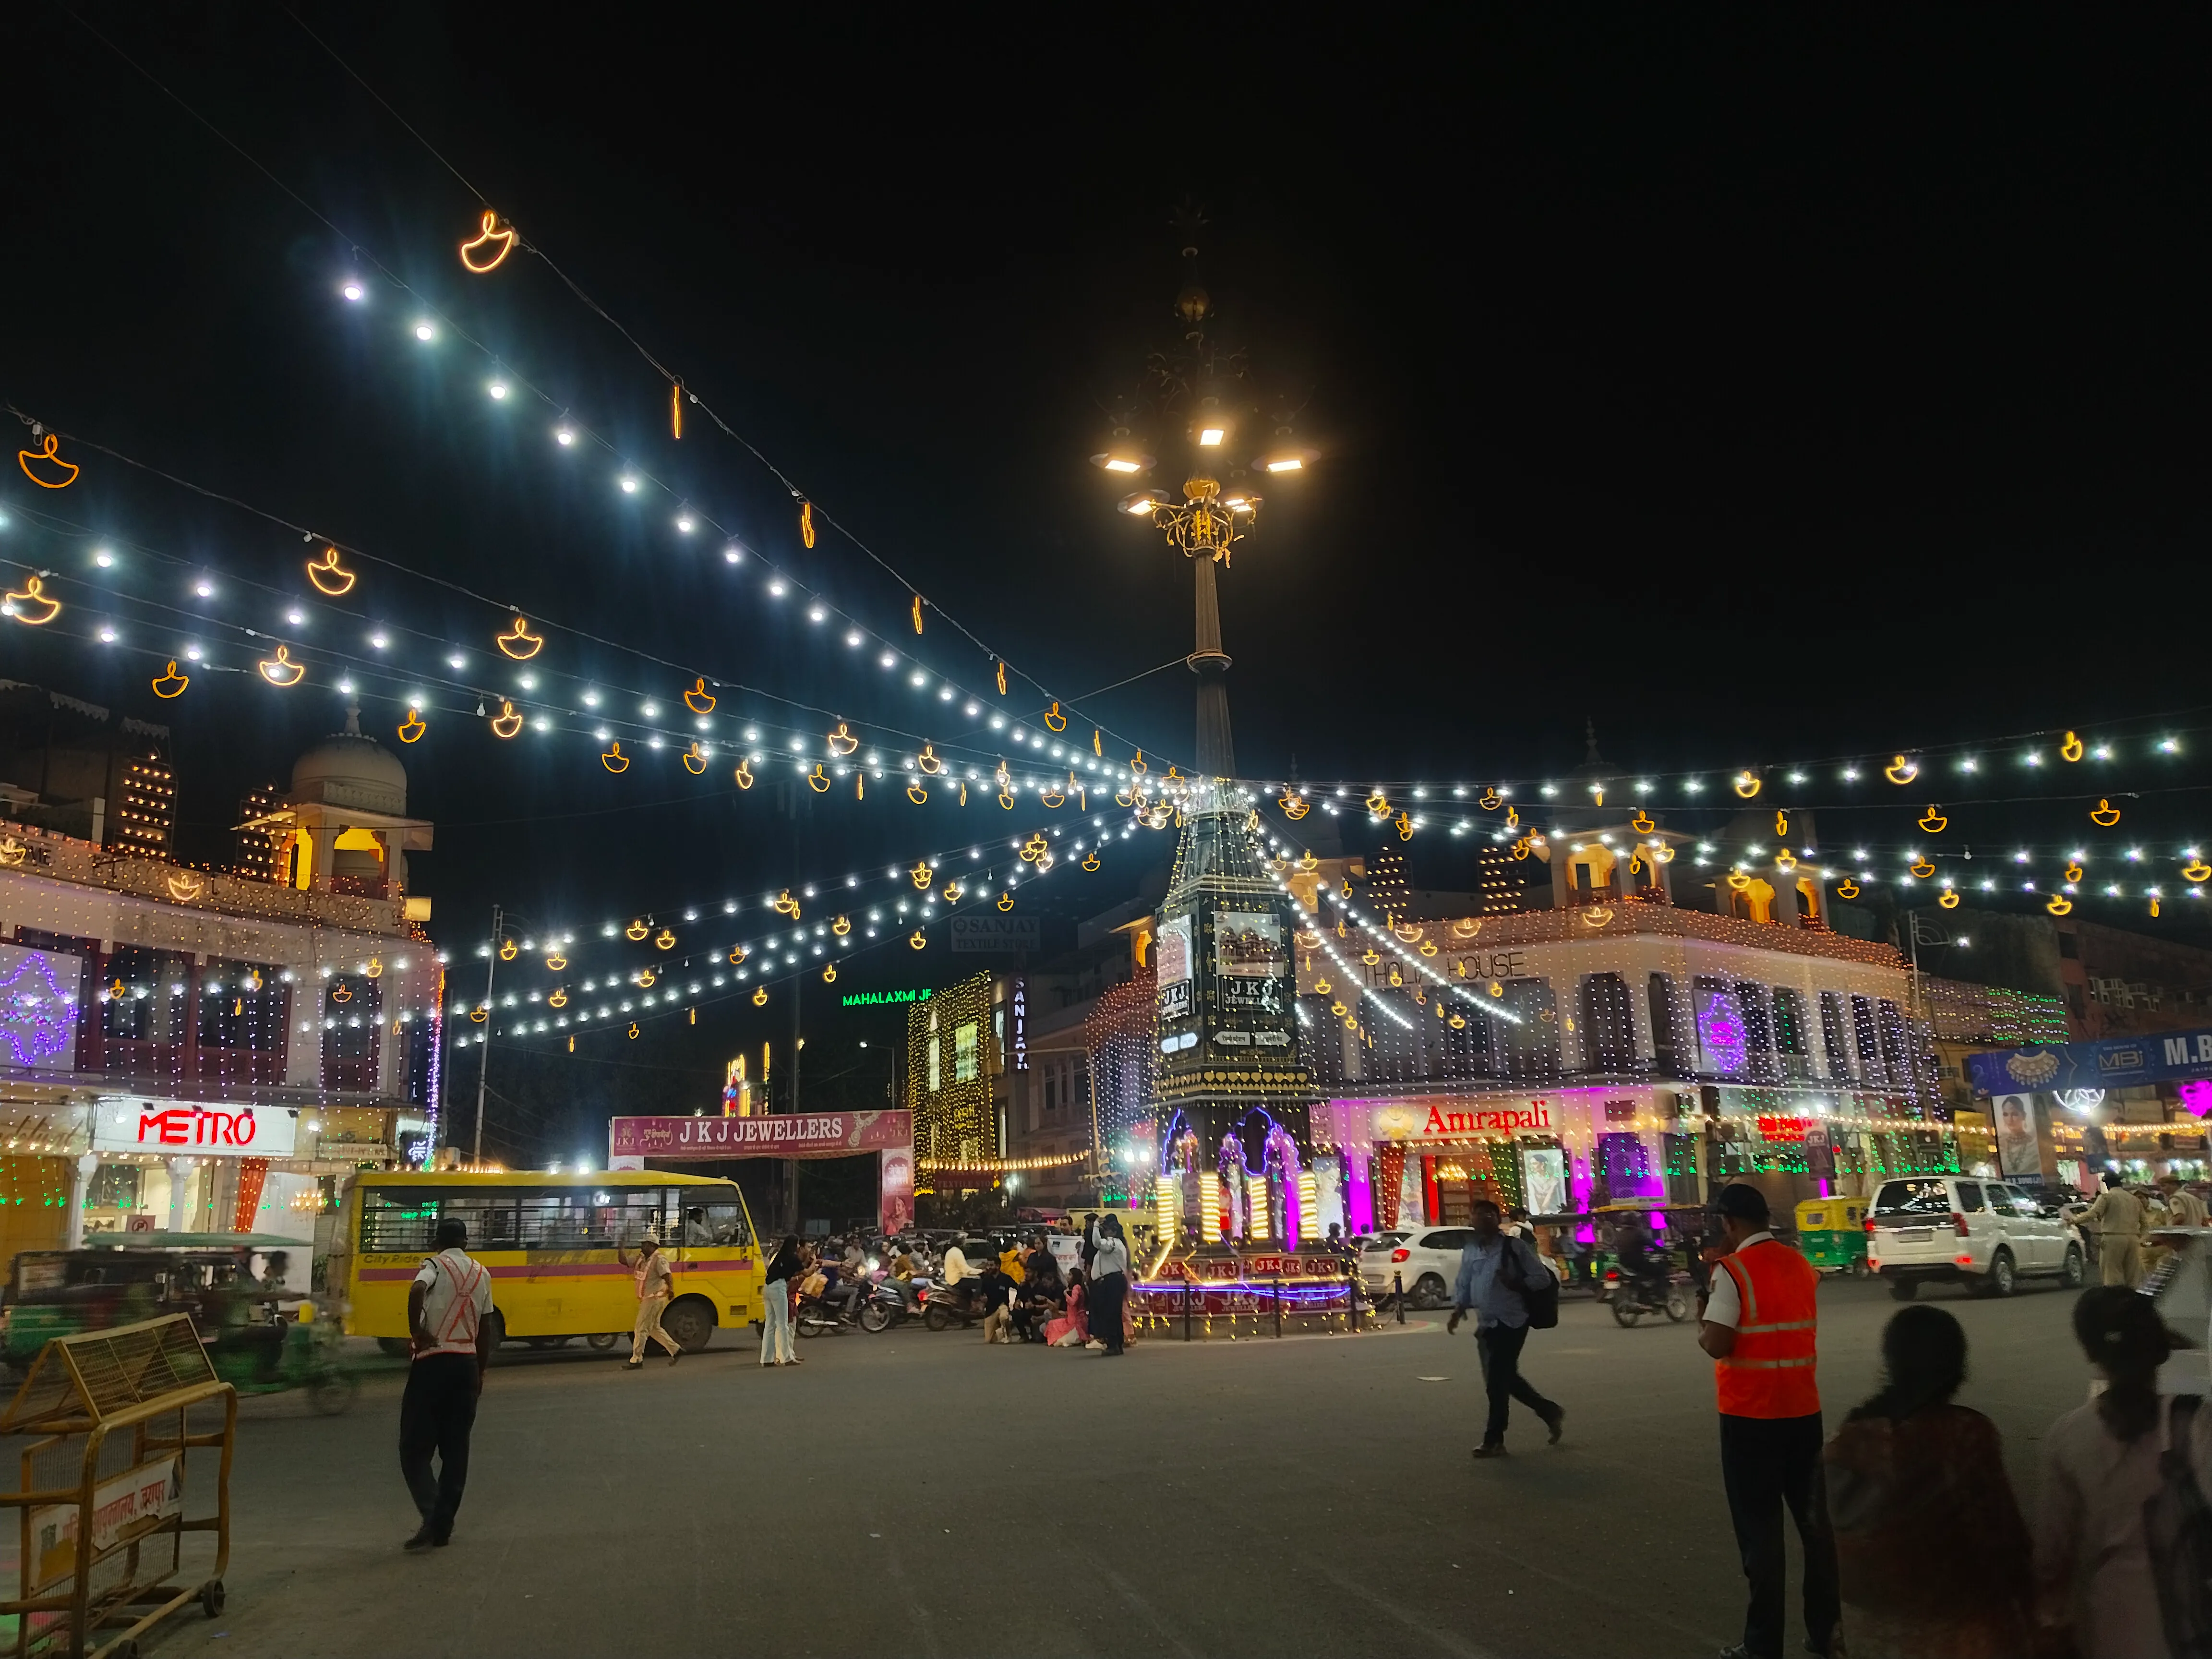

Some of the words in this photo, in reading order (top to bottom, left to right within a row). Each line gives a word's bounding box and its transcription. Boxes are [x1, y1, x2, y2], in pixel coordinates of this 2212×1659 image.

[970, 918, 1037, 934] SANJAY
[956, 938, 1000, 949] TEXTILE
[1003, 938, 1035, 950] STORE
[1447, 951, 1526, 982] HOUSE
[843, 989, 915, 1006] MAHALAXMI
[1164, 985, 1185, 1004] JKJ
[1225, 997, 1280, 1009] JEWELLRS
[1014, 977, 1026, 1062] SANJAY
[1423, 1100, 1551, 1135] Amrapali
[137, 1109, 256, 1146] METRO
[733, 1118, 842, 1142] JEWELLERS
[363, 1254, 390, 1265] City
[1257, 1260, 1282, 1271] JKJ
[1308, 1262, 1336, 1273] JKJ
[1207, 1265, 1237, 1277] JKJ
